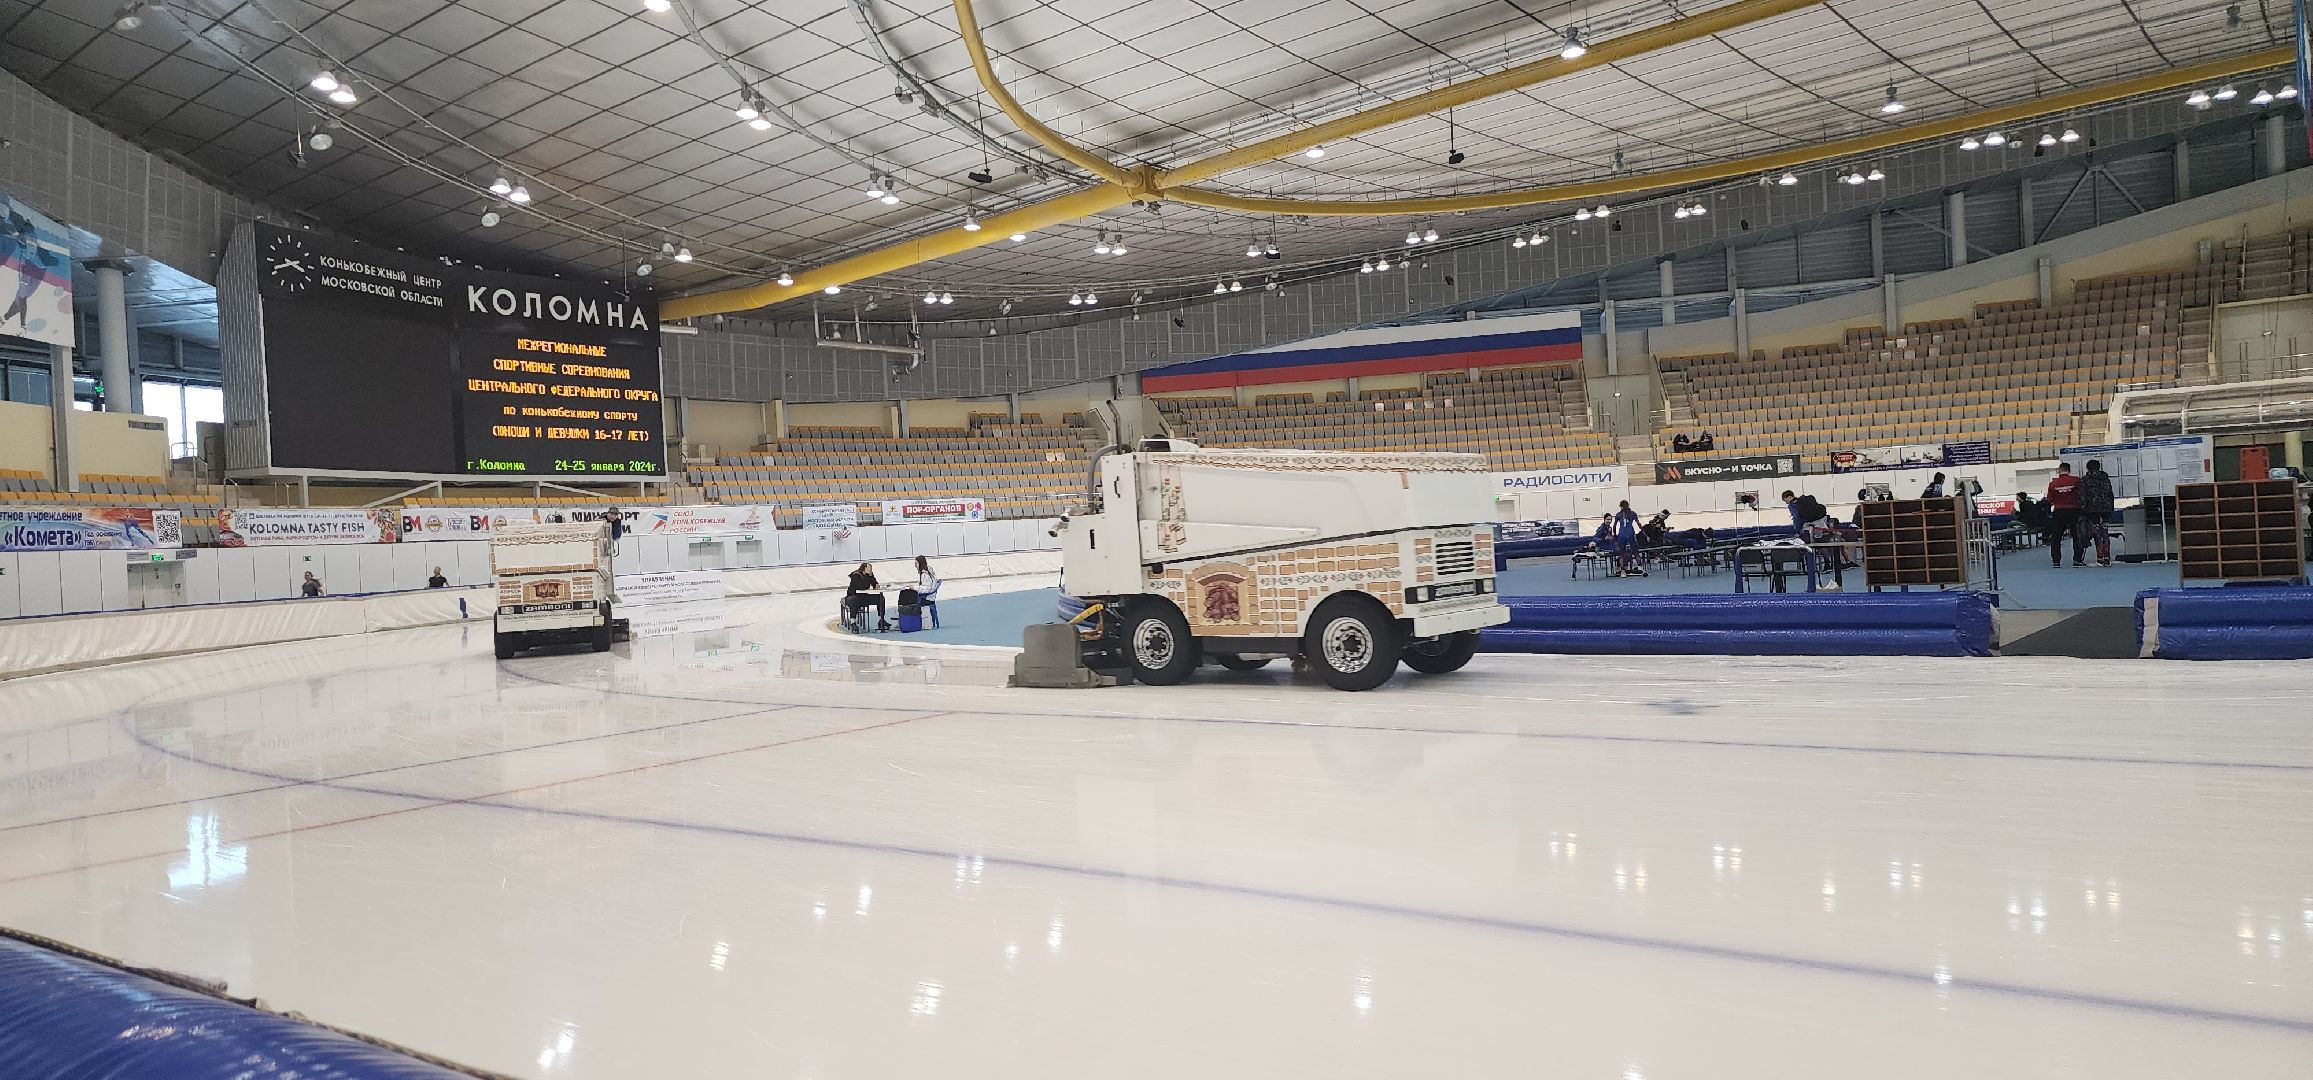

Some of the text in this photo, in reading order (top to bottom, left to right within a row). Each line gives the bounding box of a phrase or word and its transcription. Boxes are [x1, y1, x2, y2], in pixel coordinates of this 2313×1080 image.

[320, 255, 442, 290] КОНЬКОБЕЖНЫЙ ЦЕНТР
[321, 276, 444, 308] МОСКОВСКОЙ ОБЛАСТИ
[467, 284, 649, 330] КОЛОМНА
[517, 338, 607, 357] МЕЖРЕГИОНАЛЬНЫЕ
[493, 358, 631, 380] СПОРТИВНЫЕ СОРЕВНОВАНИЯ
[468, 379, 659, 402] ЦЕНТРАЛЬНОГО ФЕДЕРАЛЬНОГО ОКРУГА
[503, 406, 638, 421] по конькобежному спорту
[492, 425, 650, 442] (ЮНОШИ И ДЕВУШКИ 16-17 ЛЕТ)
[554, 459, 586, 471] 24-25
[591, 462, 625, 472] января
[629, 460, 661, 472] 2024г.
[1684, 466, 1722, 476] ВКУСНО
[1731, 465, 1739, 473] И
[1740, 463, 1773, 472] ТОЧКА
[1503, 472, 1612, 488] РАДИОСИТИ
[27, 511, 83, 524] учреждение
[4, 526, 82, 547] «Комета»
[249, 522, 365, 535] KOLOMNA TASTY FISH
[669, 526, 697, 534] РОССИИ
